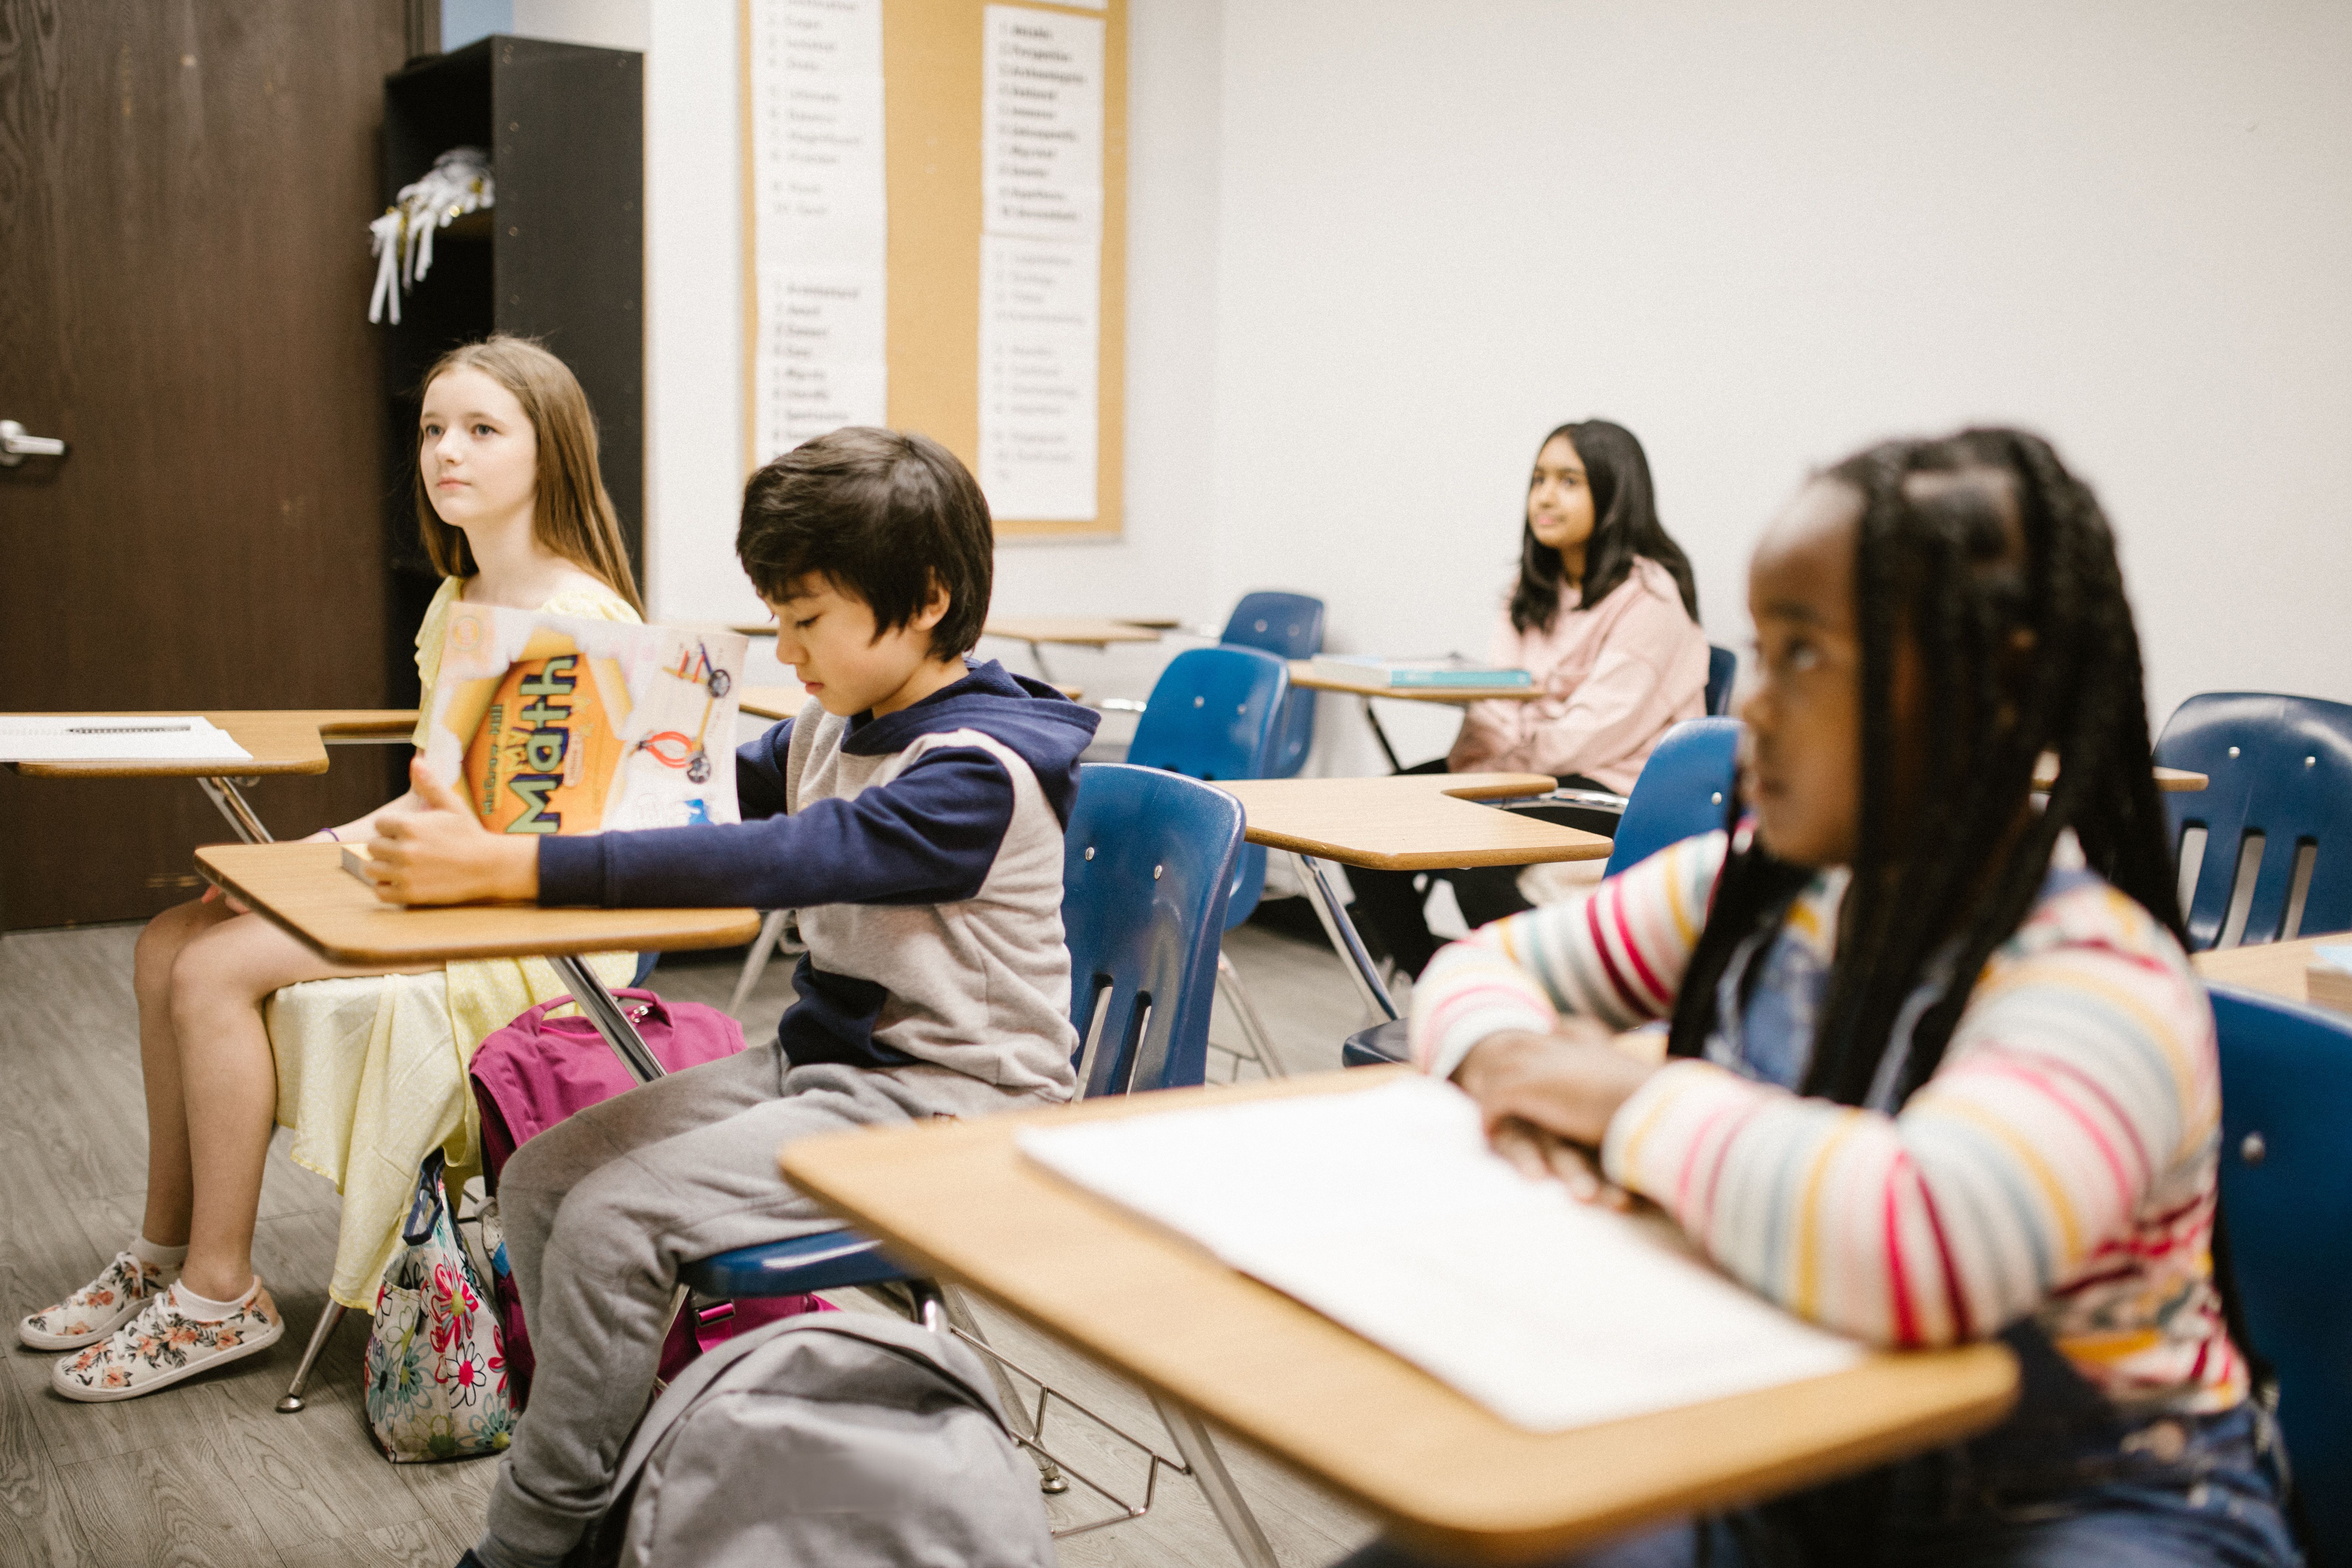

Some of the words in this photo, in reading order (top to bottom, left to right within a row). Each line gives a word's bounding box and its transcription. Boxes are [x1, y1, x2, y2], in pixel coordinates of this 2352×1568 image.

[488, 704, 503, 735] Hill
[506, 654, 577, 833] Math
[483, 744, 498, 815] McGraw
[504, 728, 531, 773] My
